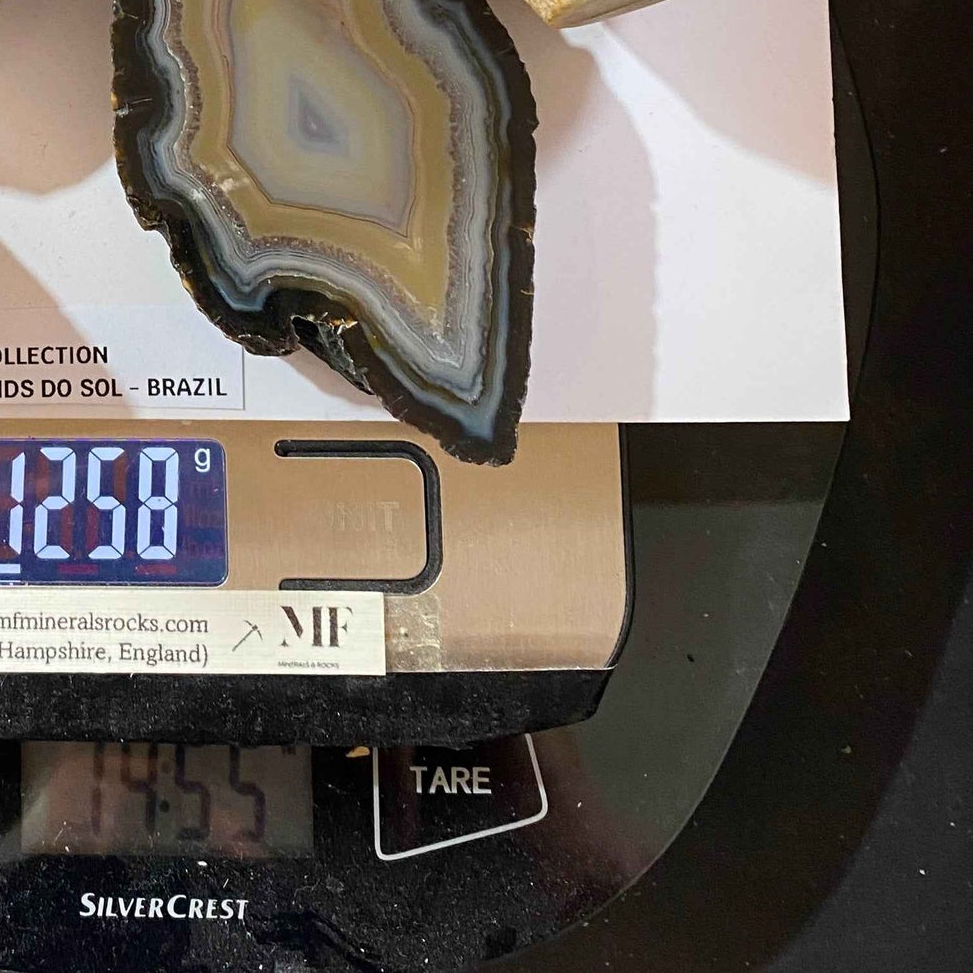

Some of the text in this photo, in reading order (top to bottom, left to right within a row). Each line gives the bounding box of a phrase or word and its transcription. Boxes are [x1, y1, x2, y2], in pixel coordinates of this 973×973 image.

[41, 379, 72, 398] DO
[80, 378, 123, 397] SOL
[147, 378, 227, 396] BRAZIL
[193, 447, 211, 473] g
[8, 447, 179, 559] 1258
[280, 605, 354, 648] MF
[118, 643, 209, 665] England)
[410, 765, 491, 795] TARE
